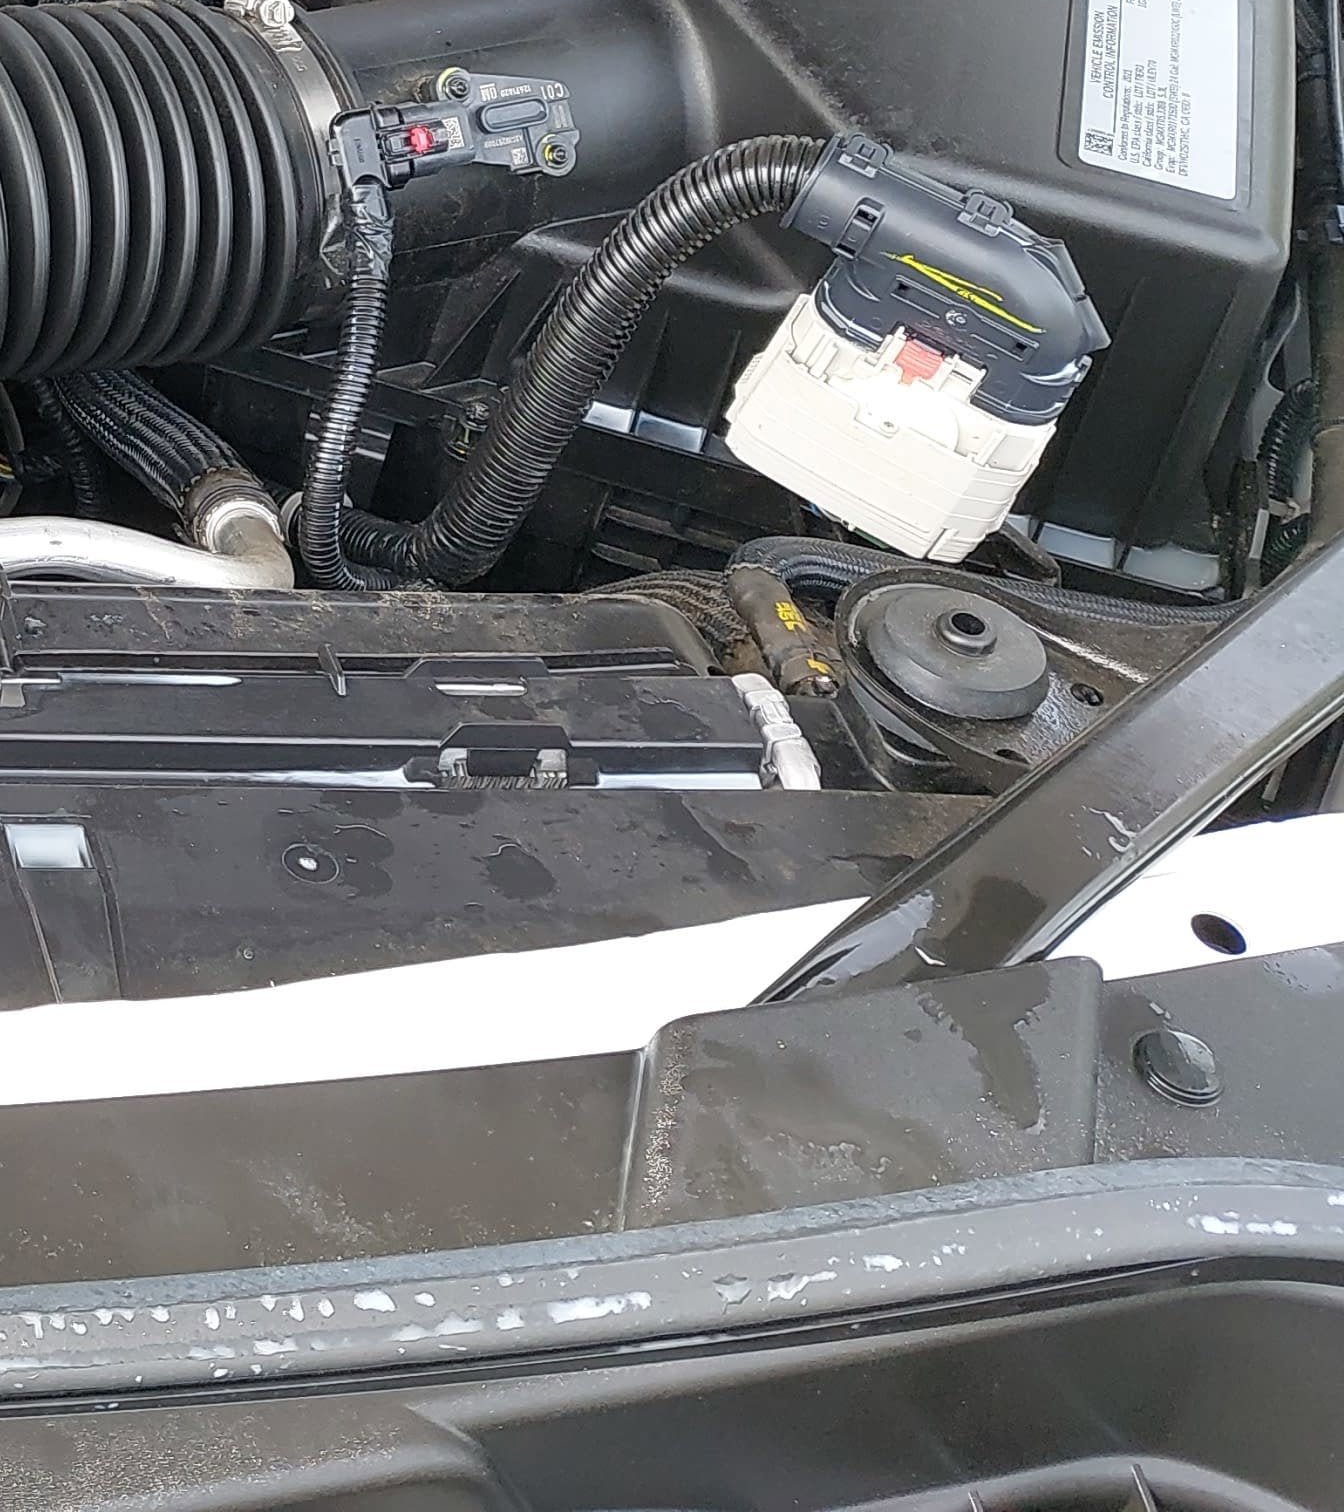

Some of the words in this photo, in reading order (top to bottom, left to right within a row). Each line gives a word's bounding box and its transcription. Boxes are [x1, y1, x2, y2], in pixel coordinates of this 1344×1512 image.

[1092, 9, 1104, 49] EMISSION
[1104, 4, 1118, 59] INFORMATION
[1089, 48, 1103, 84] VEHICLE
[1102, 57, 1116, 99] CONTROL
[1117, 128, 1129, 162] Conforms
[1130, 135, 1141, 151] EPA
[1141, 136, 1152, 168] California
